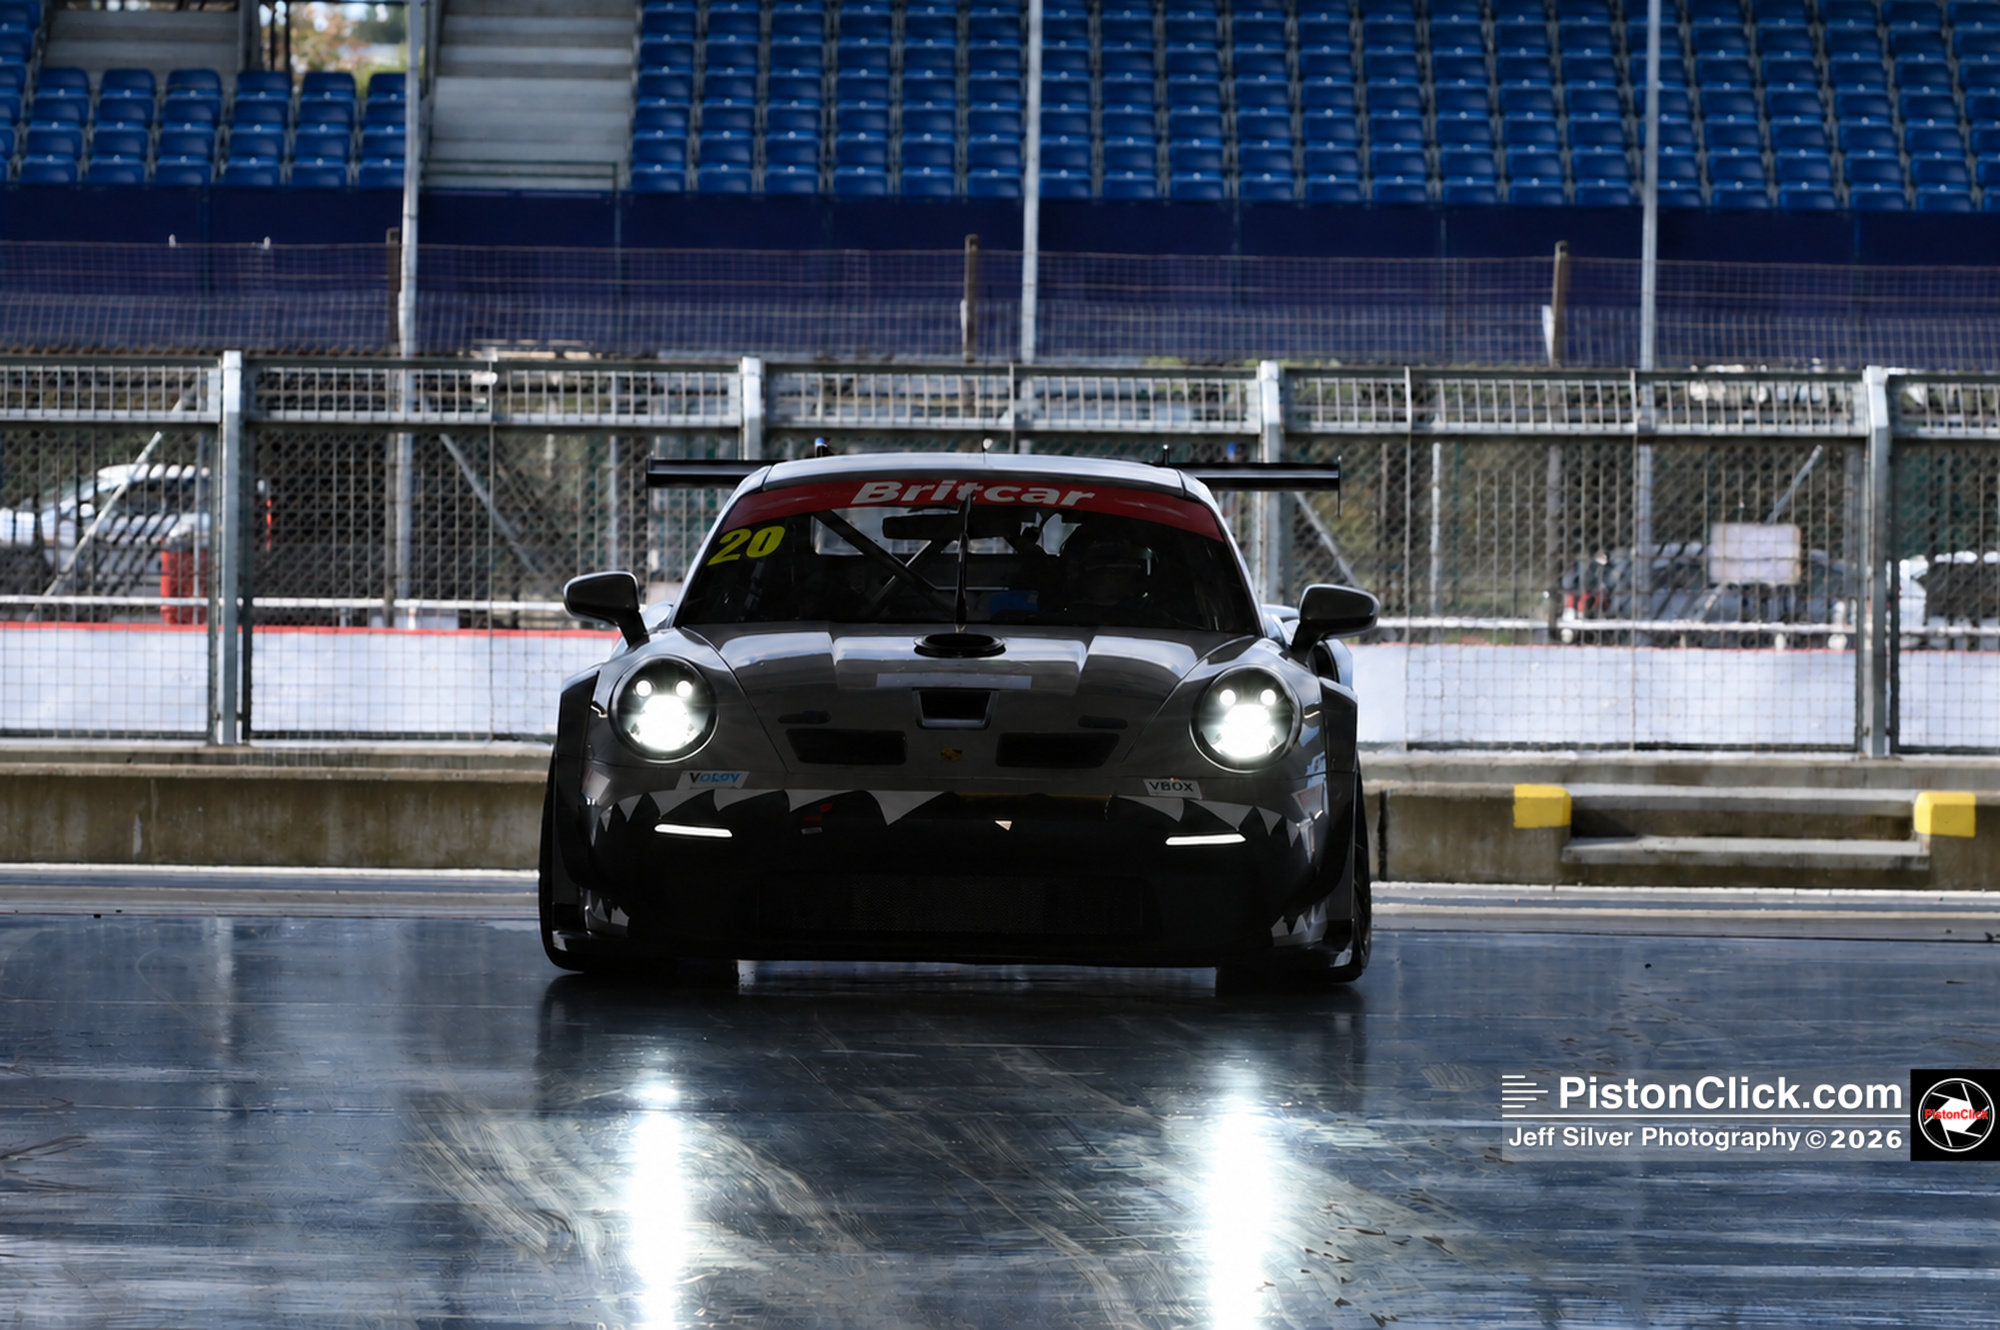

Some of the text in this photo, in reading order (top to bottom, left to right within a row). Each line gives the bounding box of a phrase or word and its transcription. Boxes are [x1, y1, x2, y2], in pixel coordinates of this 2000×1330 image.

[850, 479, 1096, 507] Britcar
[707, 525, 785, 567] 20
[1148, 781, 1194, 792] VBOX
